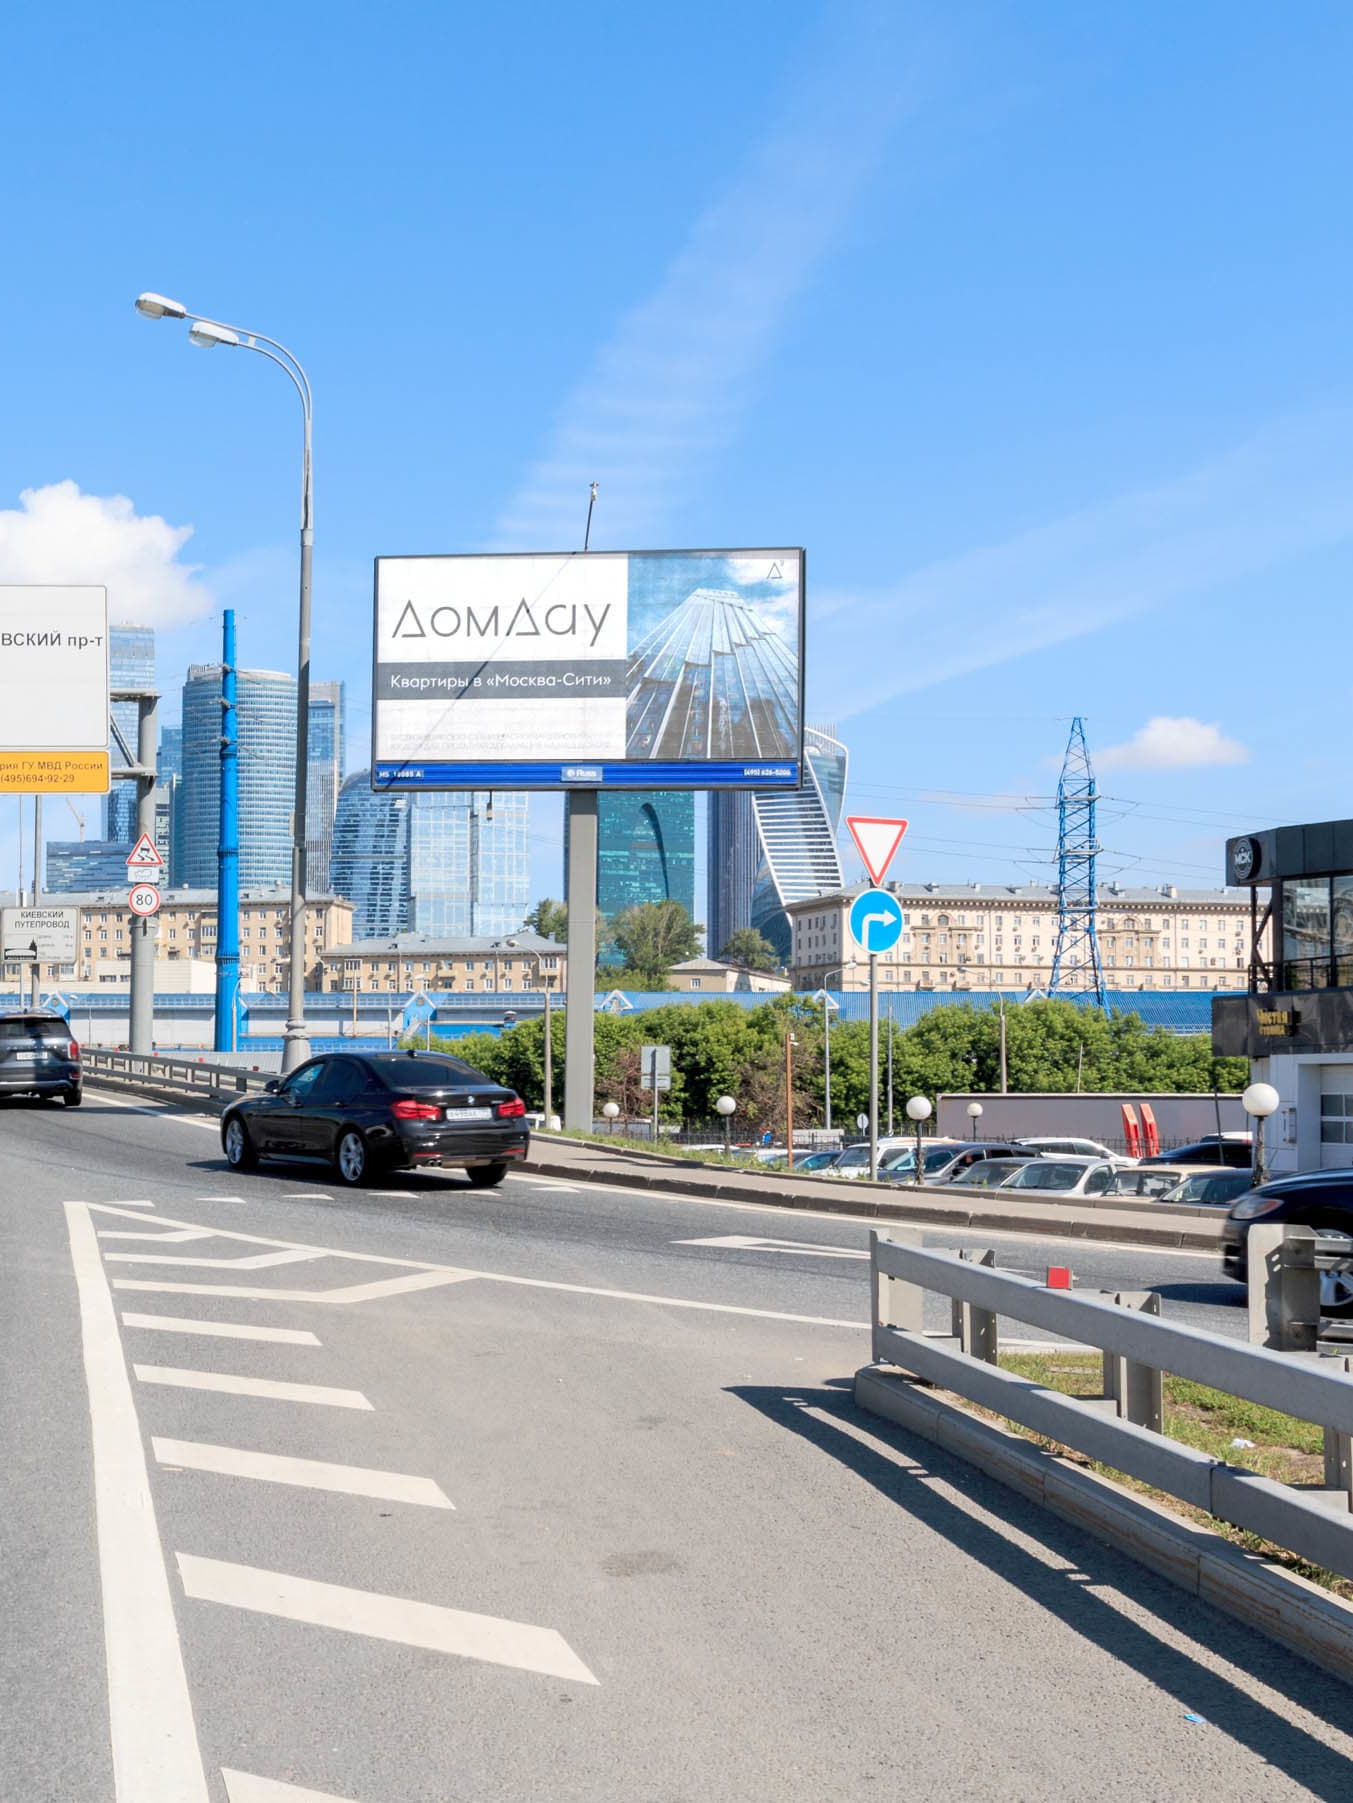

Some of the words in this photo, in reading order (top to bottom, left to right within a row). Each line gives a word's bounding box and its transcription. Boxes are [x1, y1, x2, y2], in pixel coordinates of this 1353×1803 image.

[67, 636, 103, 650] пр-т
[390, 674, 471, 690] Квартиры
[473, 677, 482, 687] в
[485, 673, 612, 688] «Москва-Сити»
[21, 761, 35, 771] ГУ
[36, 760, 62, 772] МВД
[64, 760, 104, 771] России
[136, 894, 153, 906] 80
[14, 920, 70, 929] ПУТЕПРОВОД
